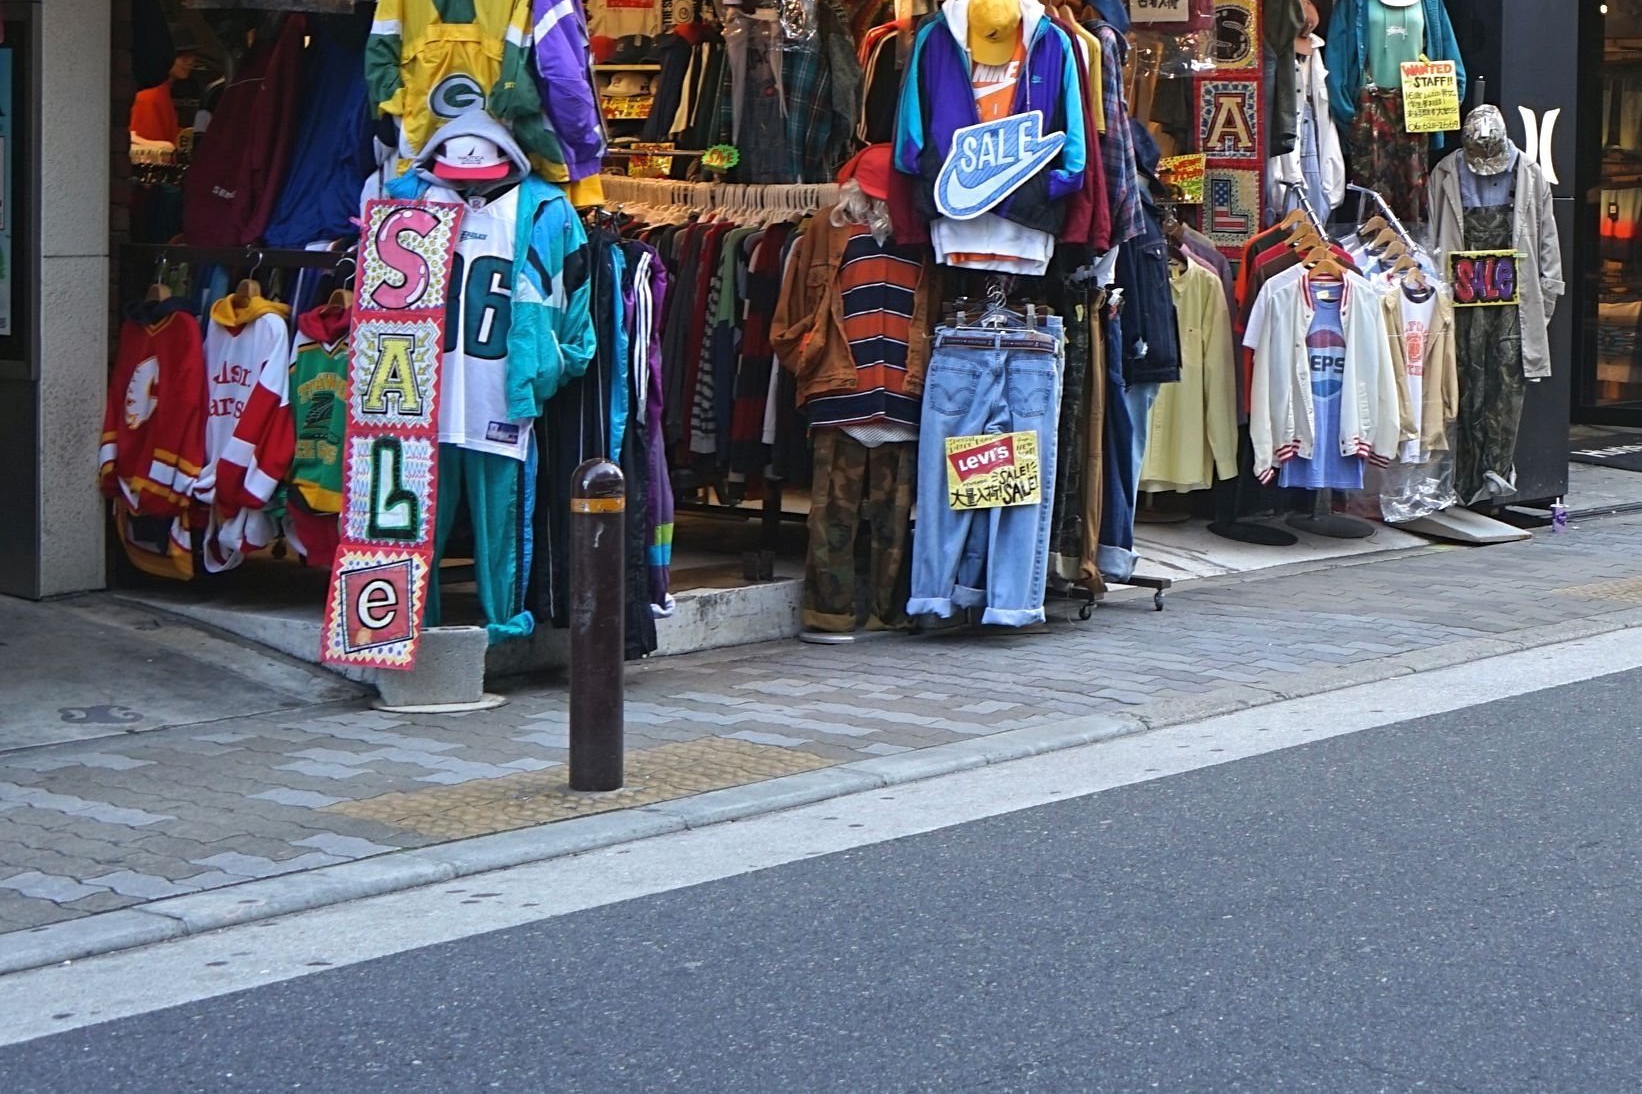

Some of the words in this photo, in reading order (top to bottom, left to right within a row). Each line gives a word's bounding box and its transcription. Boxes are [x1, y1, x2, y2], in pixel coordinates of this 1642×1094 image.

[973, 61, 1019, 82] NIKE
[1401, 63, 1452, 76] WANTED
[960, 121, 1033, 173] SALE
